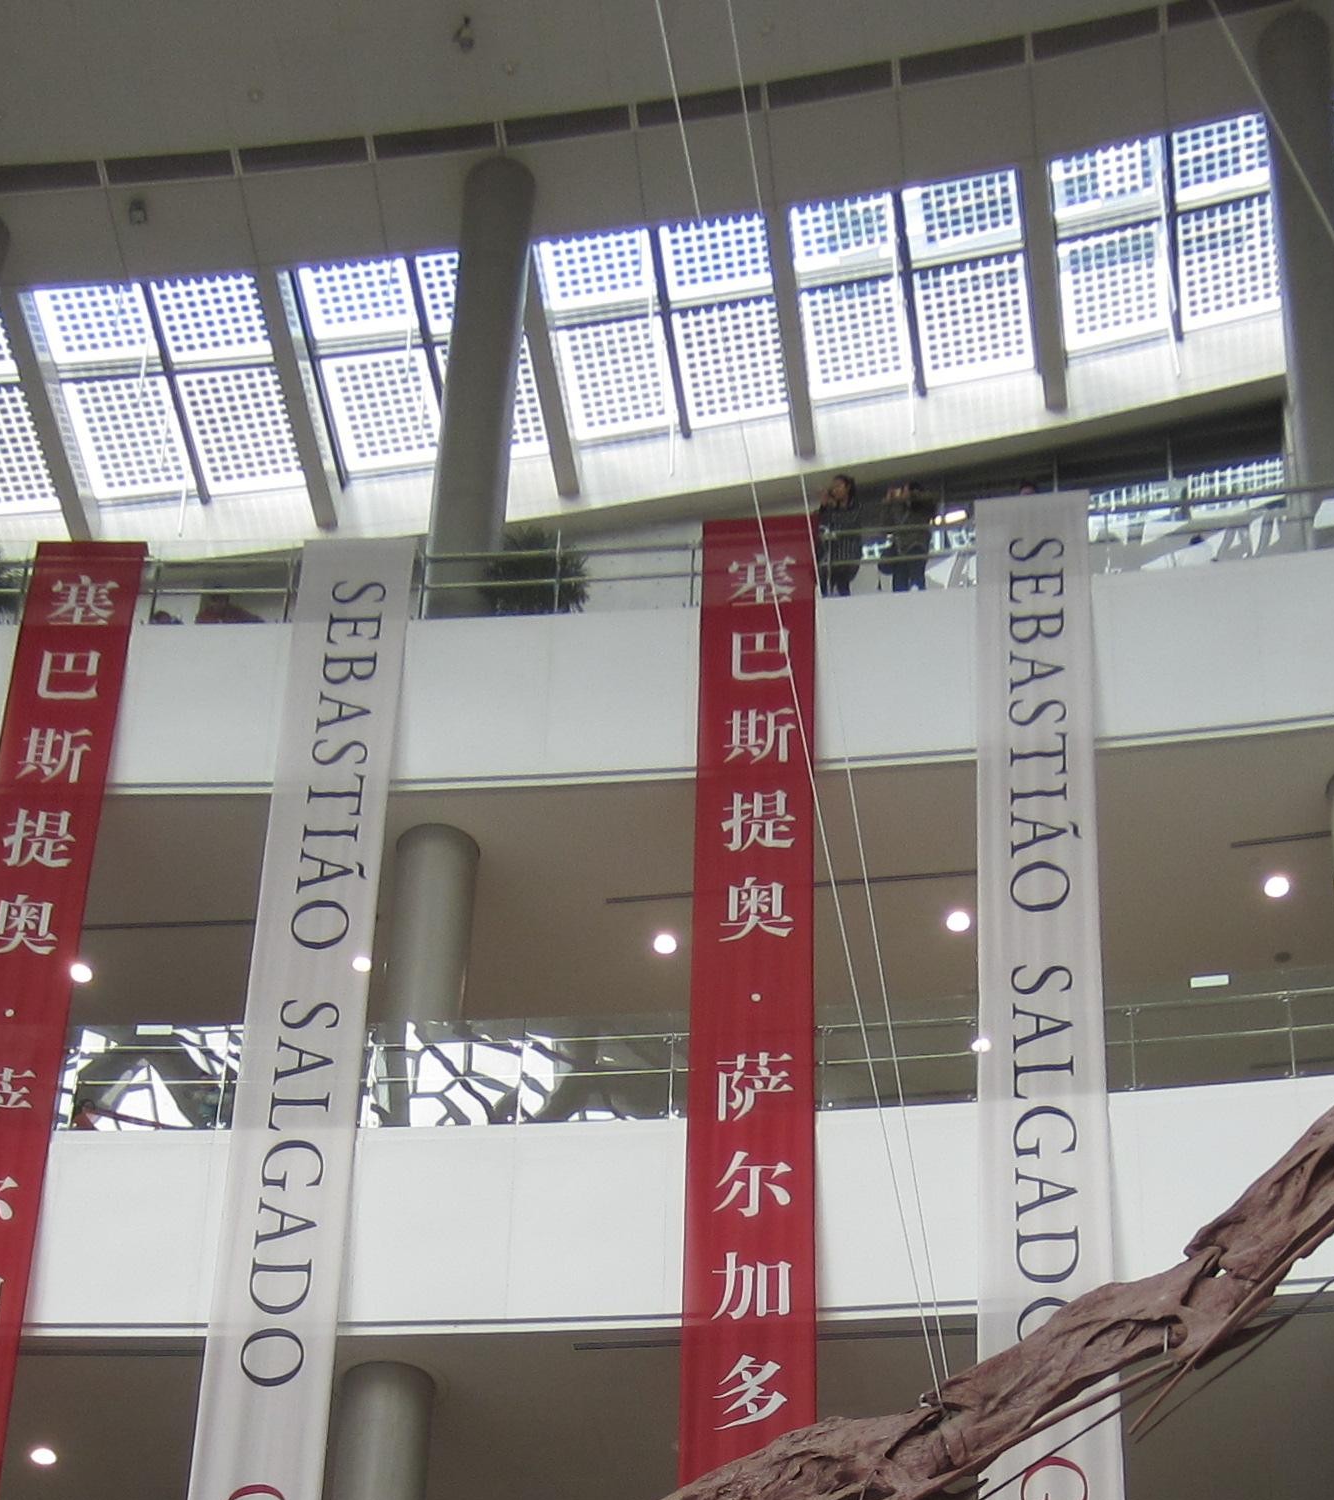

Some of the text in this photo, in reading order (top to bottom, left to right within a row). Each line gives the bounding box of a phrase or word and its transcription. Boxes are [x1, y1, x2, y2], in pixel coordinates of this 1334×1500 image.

[290, 580, 387, 951] SEBASTIÃO
[1008, 537, 1082, 913] SEBASTIÃO
[239, 999, 341, 1388] SALGADO
